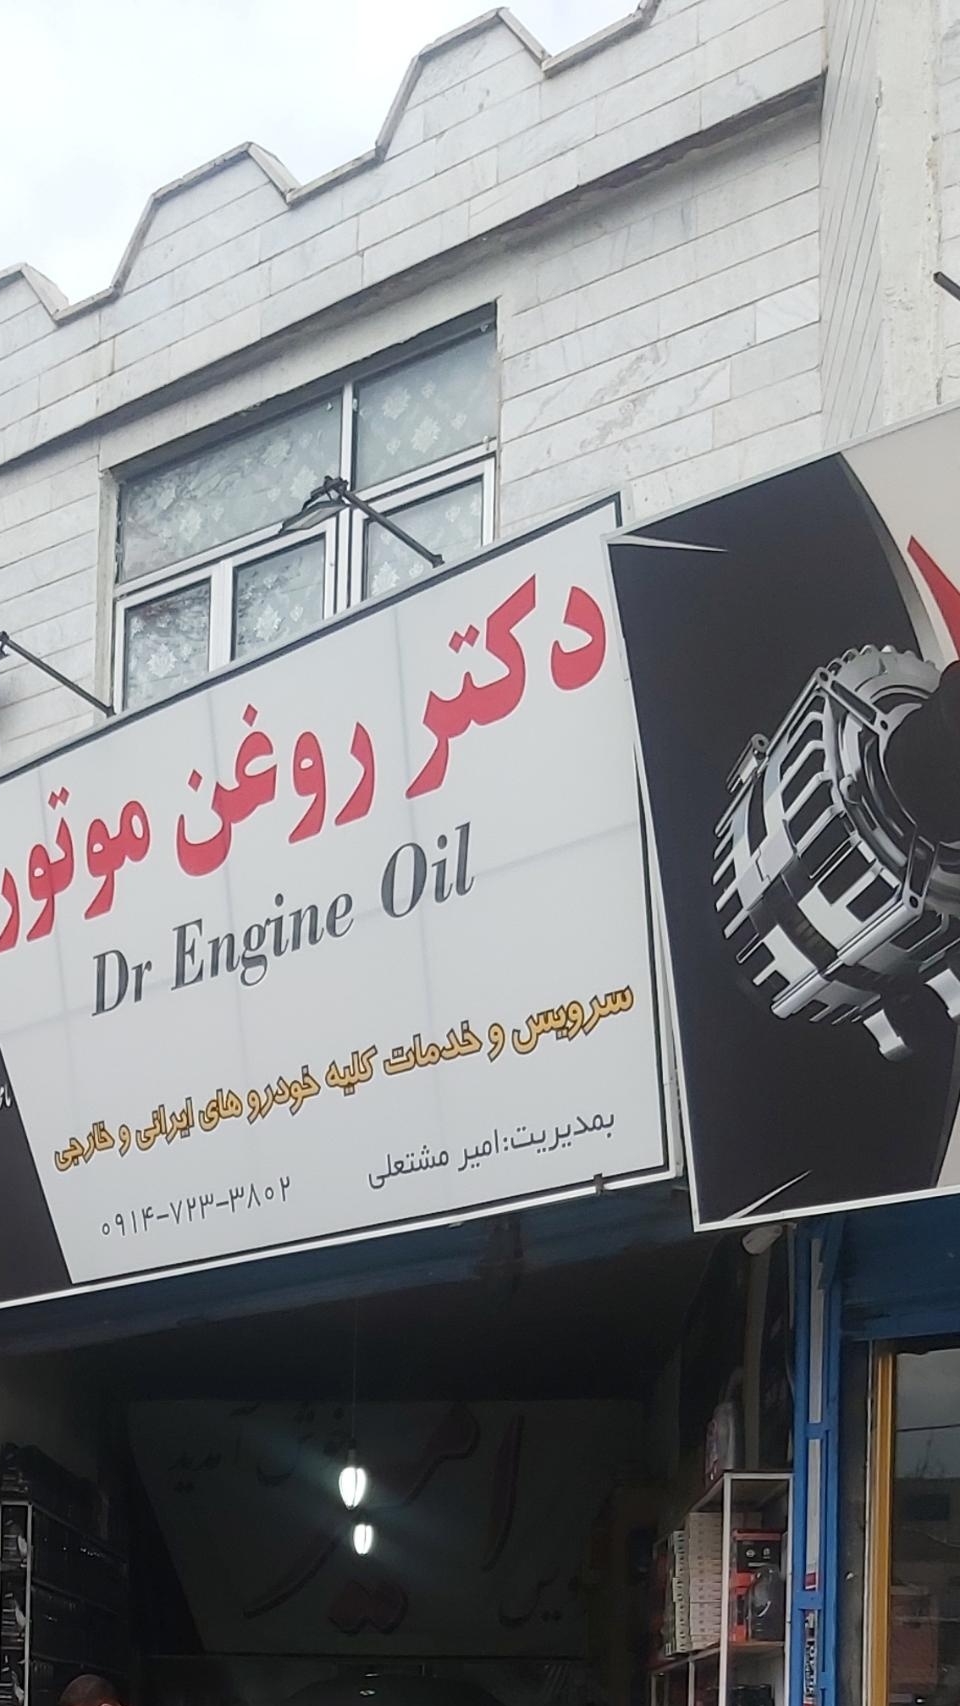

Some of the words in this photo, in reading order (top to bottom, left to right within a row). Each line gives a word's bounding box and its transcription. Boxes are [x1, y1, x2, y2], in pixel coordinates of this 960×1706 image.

[405, 574, 608, 798] دکتر
[175, 704, 375, 876] روغن
[92, 949, 152, 1016] Dr
[171, 893, 353, 990] Engine
[381, 821, 475, 919] Oil
[487, 1022, 505, 1062] و
[512, 985, 634, 1055] سرویس
[325, 1045, 378, 1096] کلیه
[383, 1020, 483, 1075] خدمات
[136, 1096, 194, 1150] ایرانی
[198, 1088, 243, 1131] های
[54, 1120, 115, 1171] خارجی
[119, 1123, 132, 1157] و
[368, 1144, 449, 1189] مشتعلی
